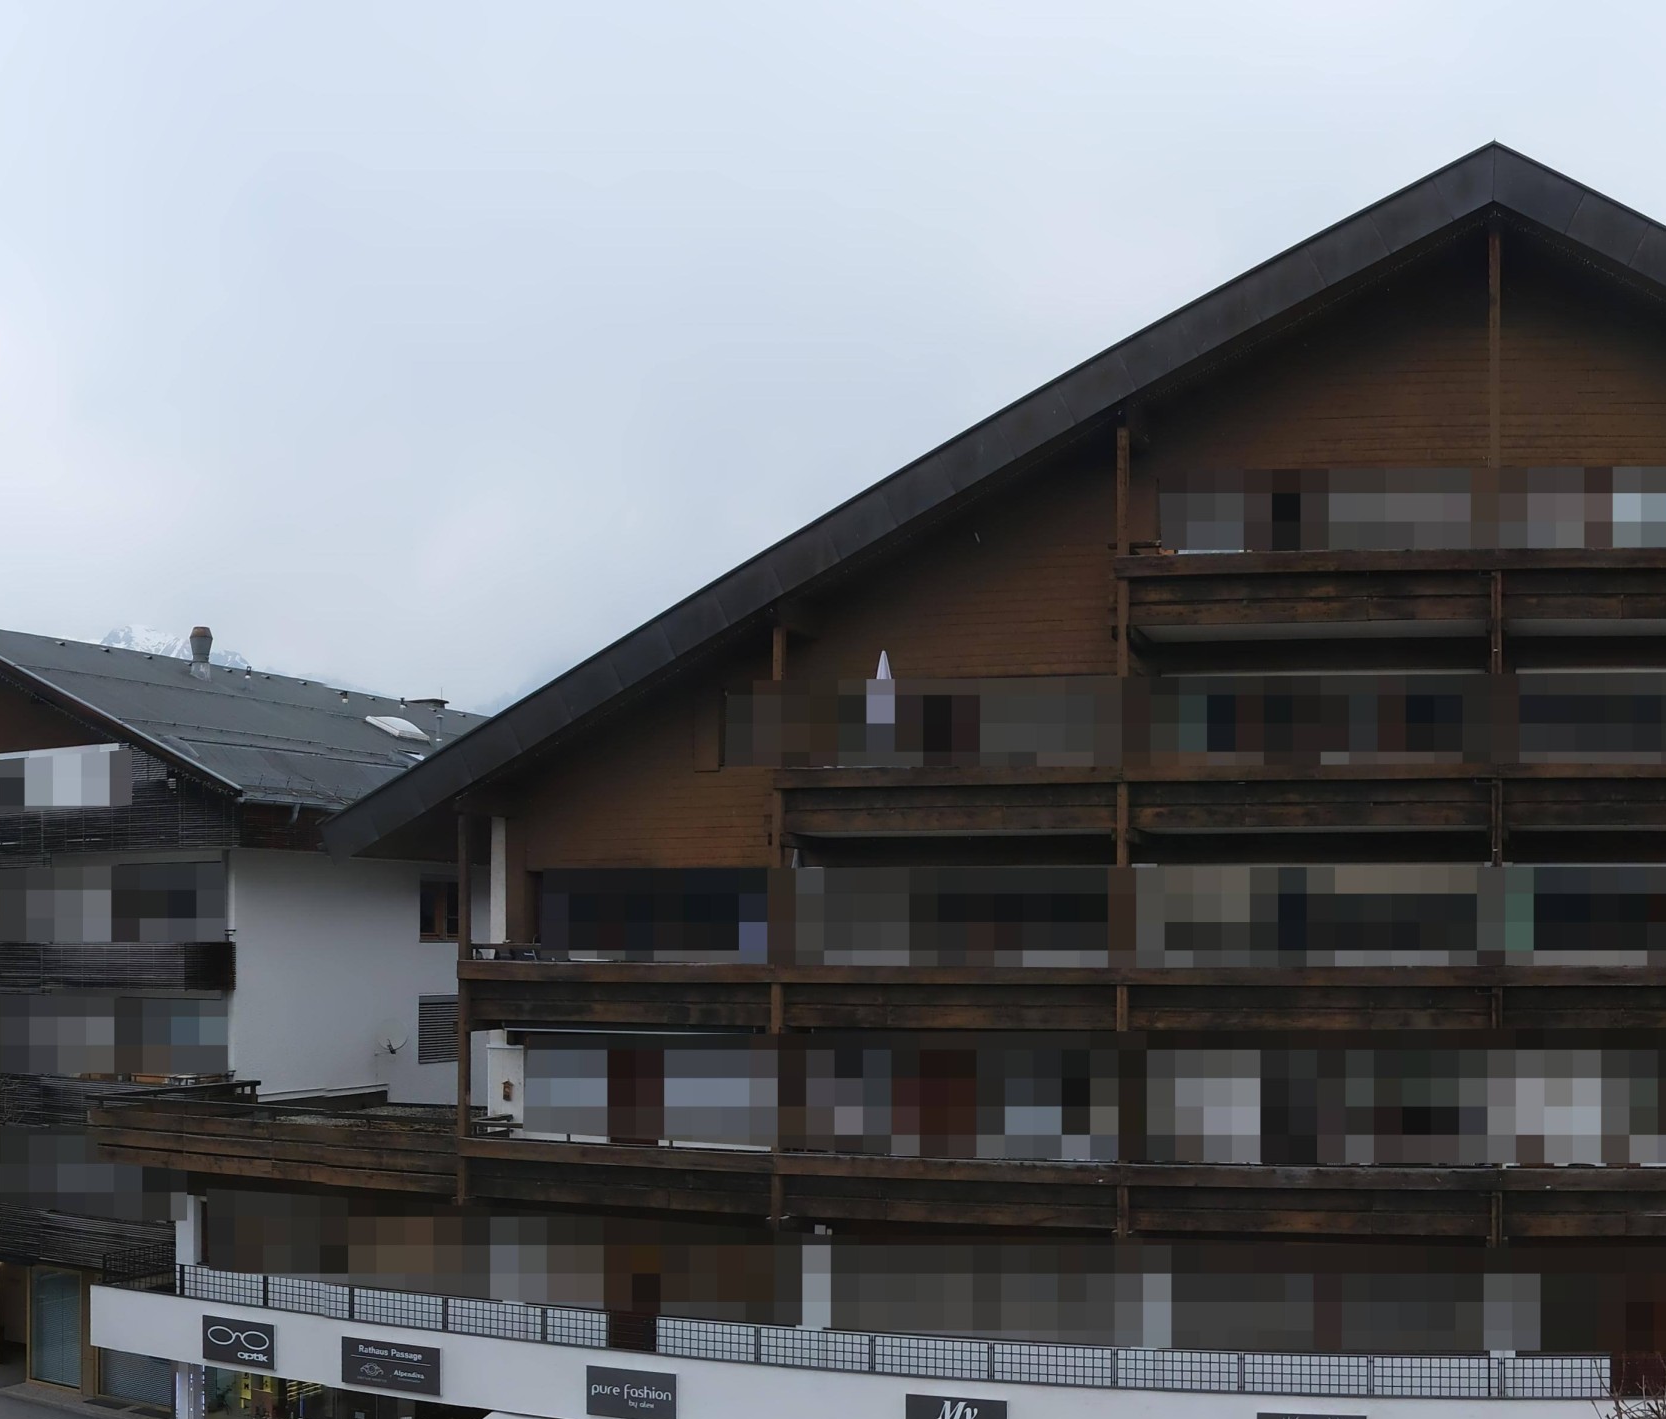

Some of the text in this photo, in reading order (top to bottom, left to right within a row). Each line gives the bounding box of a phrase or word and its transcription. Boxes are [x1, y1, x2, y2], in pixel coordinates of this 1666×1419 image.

[237, 1351, 269, 1363] optik
[358, 1344, 422, 1361] Rathaus Passage
[591, 1383, 671, 1400] pure fashion
[628, 1399, 638, 1409] by
